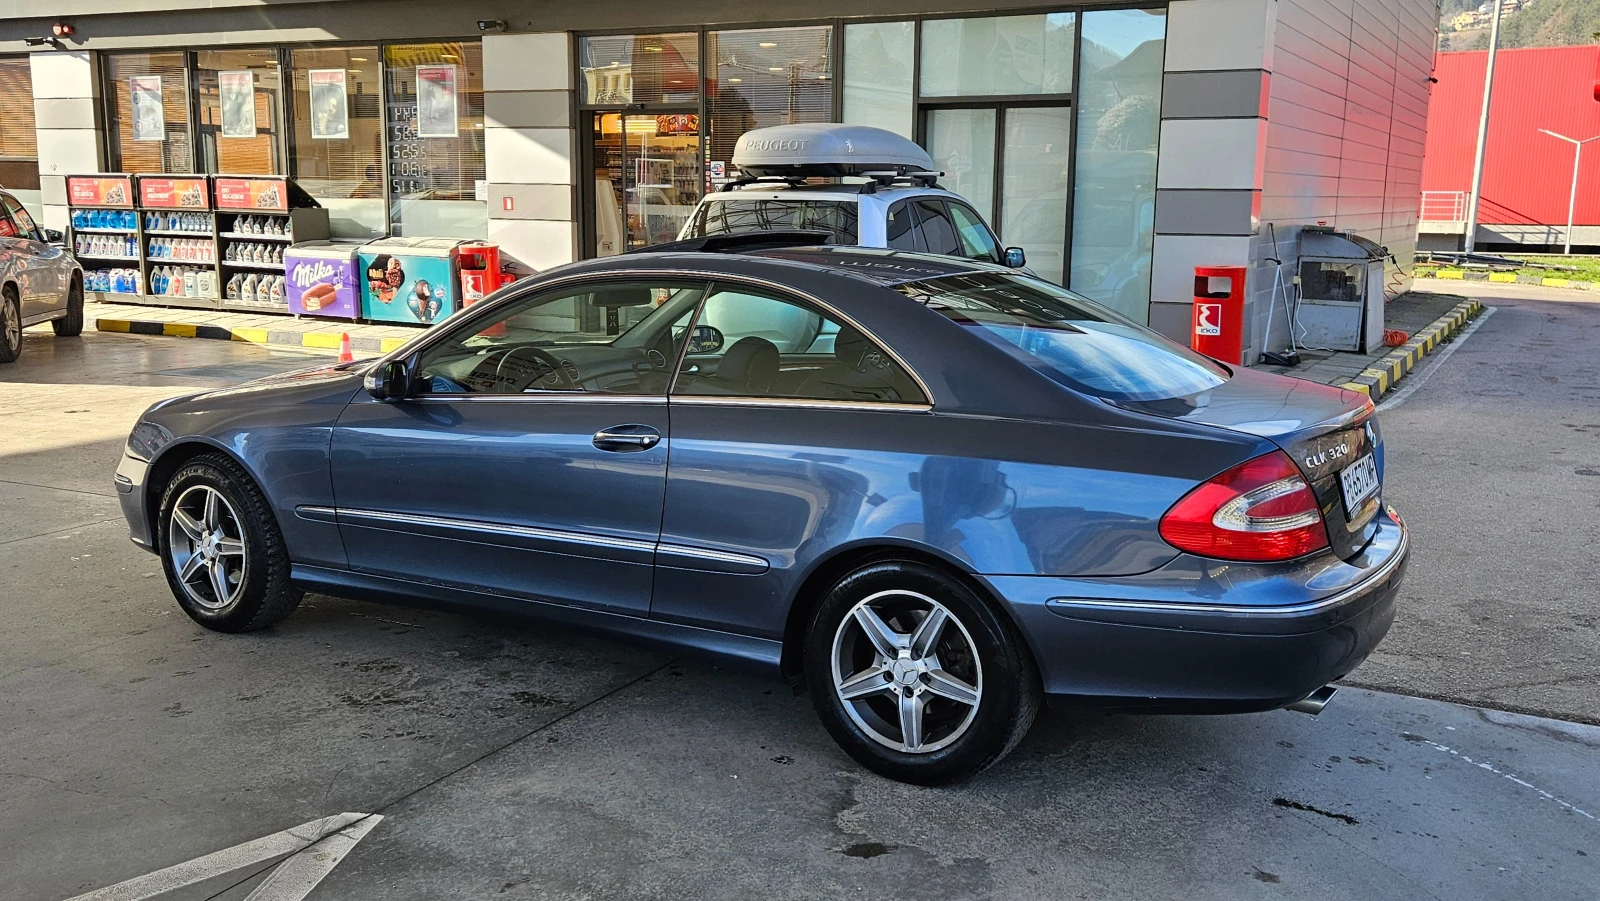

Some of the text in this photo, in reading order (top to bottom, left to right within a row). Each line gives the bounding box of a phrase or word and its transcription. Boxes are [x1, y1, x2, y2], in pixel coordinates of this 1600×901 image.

[745, 139, 808, 151] PEUGEOT
[292, 260, 335, 288] Milka
[1305, 443, 1348, 468] CLK 320
